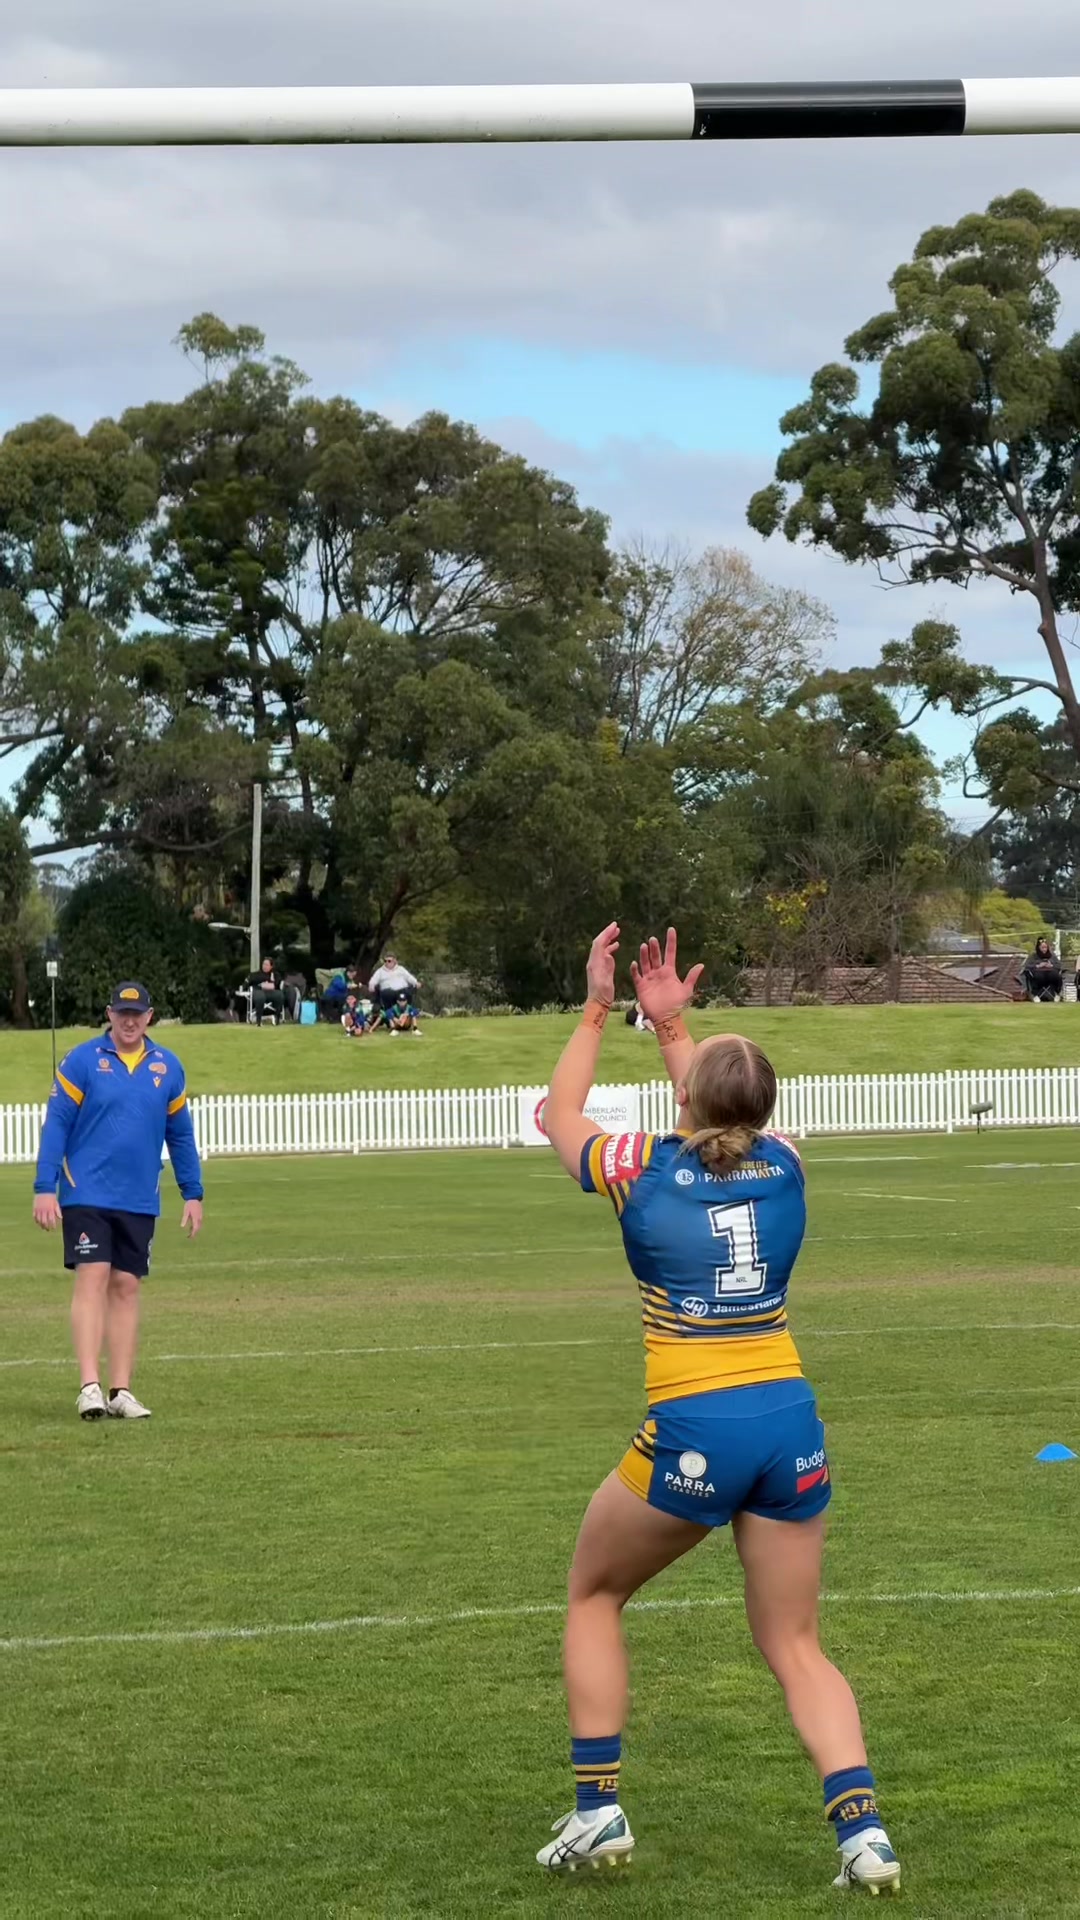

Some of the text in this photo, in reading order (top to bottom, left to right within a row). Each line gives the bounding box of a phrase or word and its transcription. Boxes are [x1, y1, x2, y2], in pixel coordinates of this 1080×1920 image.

[584, 1106, 628, 1114] MBERLAND
[593, 1114, 628, 1122] COUNCIL
[704, 1165, 785, 1183] PARRAMATTA
[707, 1199, 767, 1297] 1
[664, 1471, 716, 1493] PARRA
[667, 1484, 710, 1498] LEAGUES
